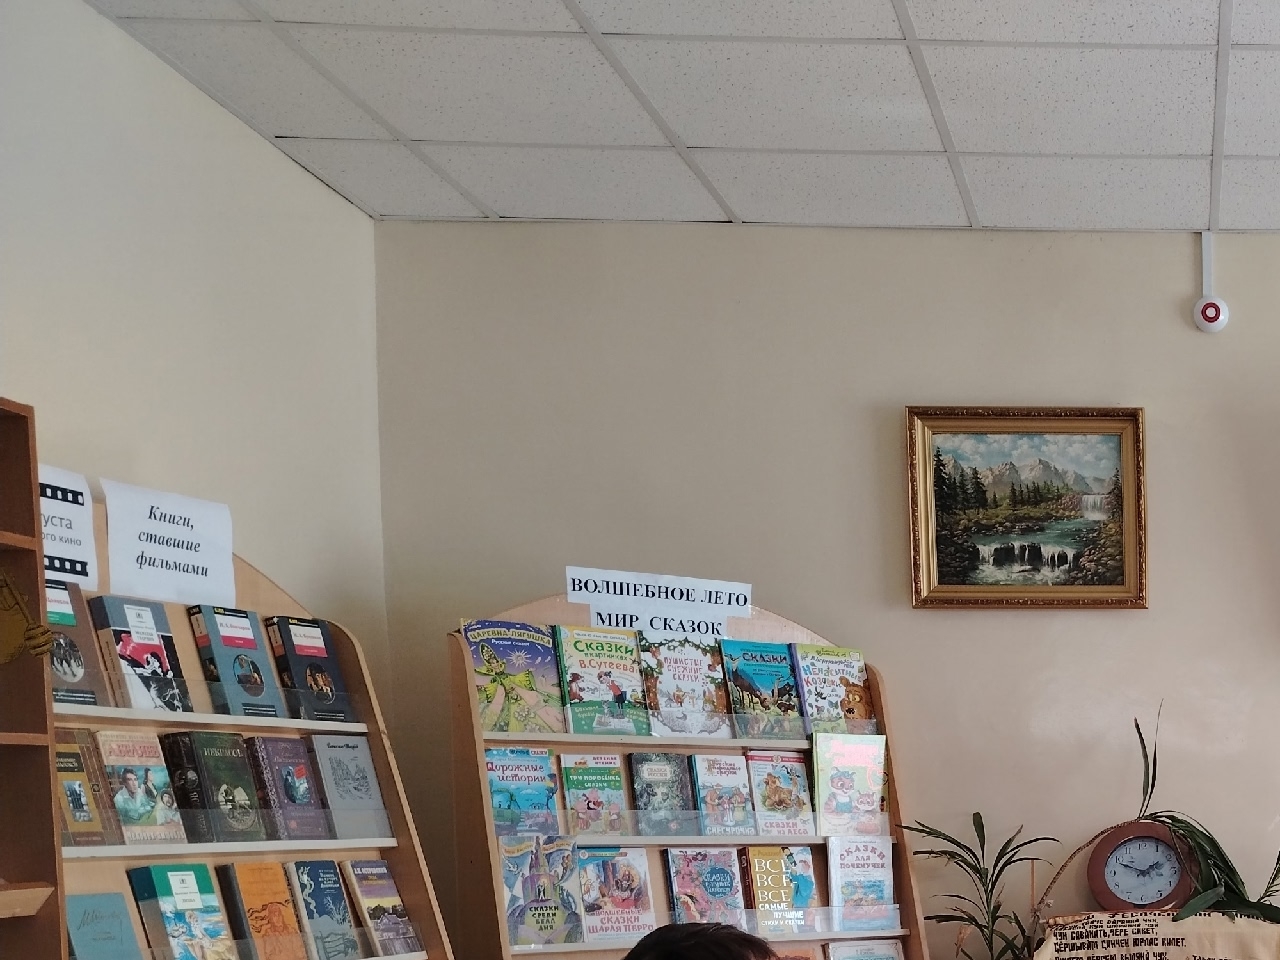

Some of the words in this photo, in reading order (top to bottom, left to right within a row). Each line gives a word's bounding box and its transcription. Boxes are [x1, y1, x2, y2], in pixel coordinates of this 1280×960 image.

[40, 513, 73, 530] уста
[148, 504, 194, 532] Книги,
[58, 536, 82, 547] кино
[138, 531, 201, 553] ставшие
[136, 550, 209, 577] фильмами
[570, 577, 696, 603] ВОЛШЕБНОЕ
[700, 589, 748, 607] ЛЕТО
[595, 611, 640, 629] МИР
[649, 616, 723, 636] СКАЗОК
[573, 640, 635, 656] Сказки
[741, 652, 789, 664] СКАЗКИ
[579, 658, 636, 673] В.Сутеева
[486, 761, 545, 773] Дорожные
[497, 773, 547, 785] истории
[839, 844, 886, 860] СКАЗКИ
[839, 861, 887, 869] ПОЧЕМУЧЕК
[758, 889, 791, 902] ВСЕ
[759, 903, 789, 911] САМЫЕ
[600, 916, 640, 925] СКАЗКИ
[773, 911, 804, 919] ЛУЧШИЕ
[588, 925, 622, 934] ШАРЛЯ
[623, 924, 654, 932] ПЕРРО
